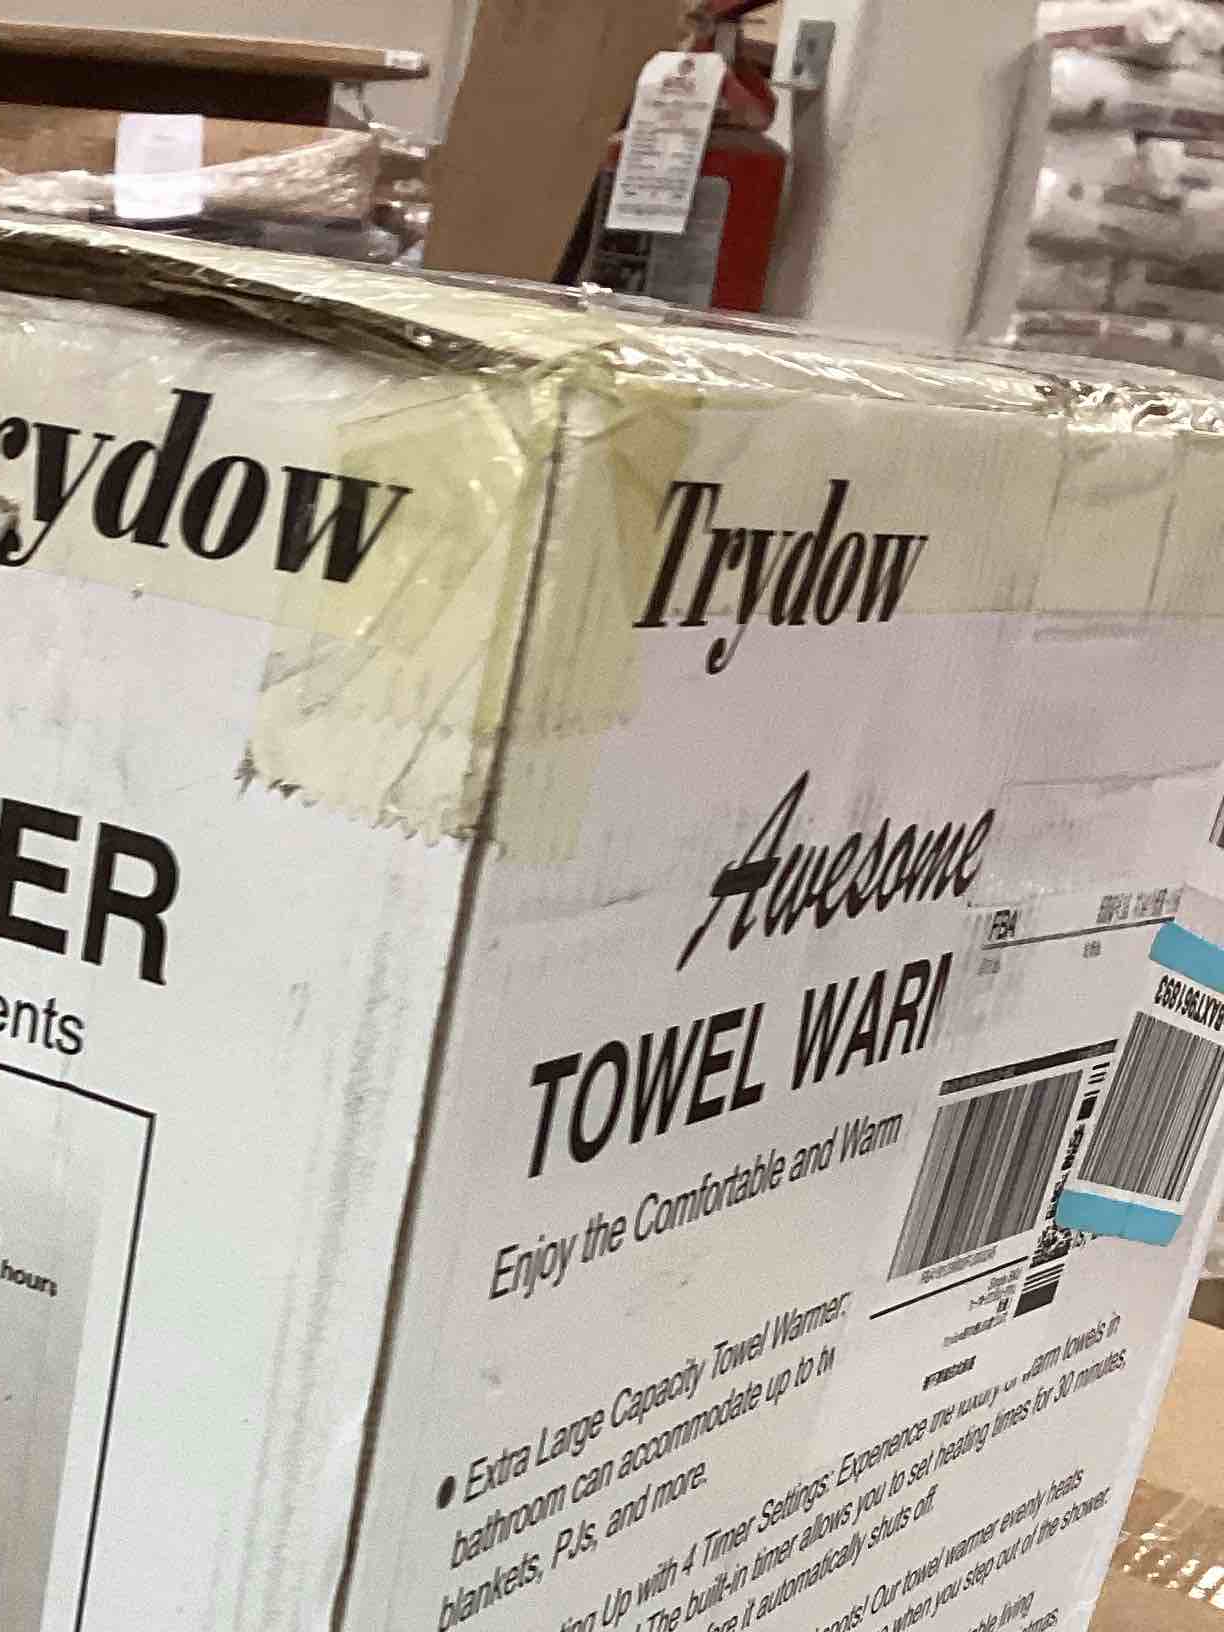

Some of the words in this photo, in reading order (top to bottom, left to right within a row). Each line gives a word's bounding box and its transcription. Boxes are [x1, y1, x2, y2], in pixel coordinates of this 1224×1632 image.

[632, 479, 929, 674] Trydow
[675, 771, 997, 971] Awesome
[529, 1003, 766, 1178] TOWEL
[0, 1259, 56, 1297] hours
[488, 1233, 578, 1300] Enjoy
[580, 1212, 626, 1263] the
[633, 1148, 785, 1242] Comfortable
[788, 1126, 838, 1182] and
[839, 1113, 903, 1162] Warm
[449, 1483, 567, 1569] bathroom
[571, 1459, 614, 1503] can
[617, 1381, 762, 1479] accommodate
[764, 1368, 791, 1405] up
[793, 1356, 814, 1387] to
[462, 1445, 531, 1503] Extra
[534, 1408, 604, 1466] Large
[610, 1358, 705, 1428] Capacity
[711, 1320, 770, 1379] Towel
[550, 1519, 597, 1569] PJs,
[605, 1483, 651, 1537] and
[650, 1461, 707, 1512] more.
[740, 1597, 755, 1630] it
[755, 1531, 867, 1620] automatically
[867, 1505, 912, 1549] shuts
[870, 1578, 902, 1615] Our
[901, 1546, 945, 1595] towel
[944, 1518, 1000, 1567] warmer
[999, 1490, 1046, 1533] evenly
[1045, 1469, 1083, 1505] heats
